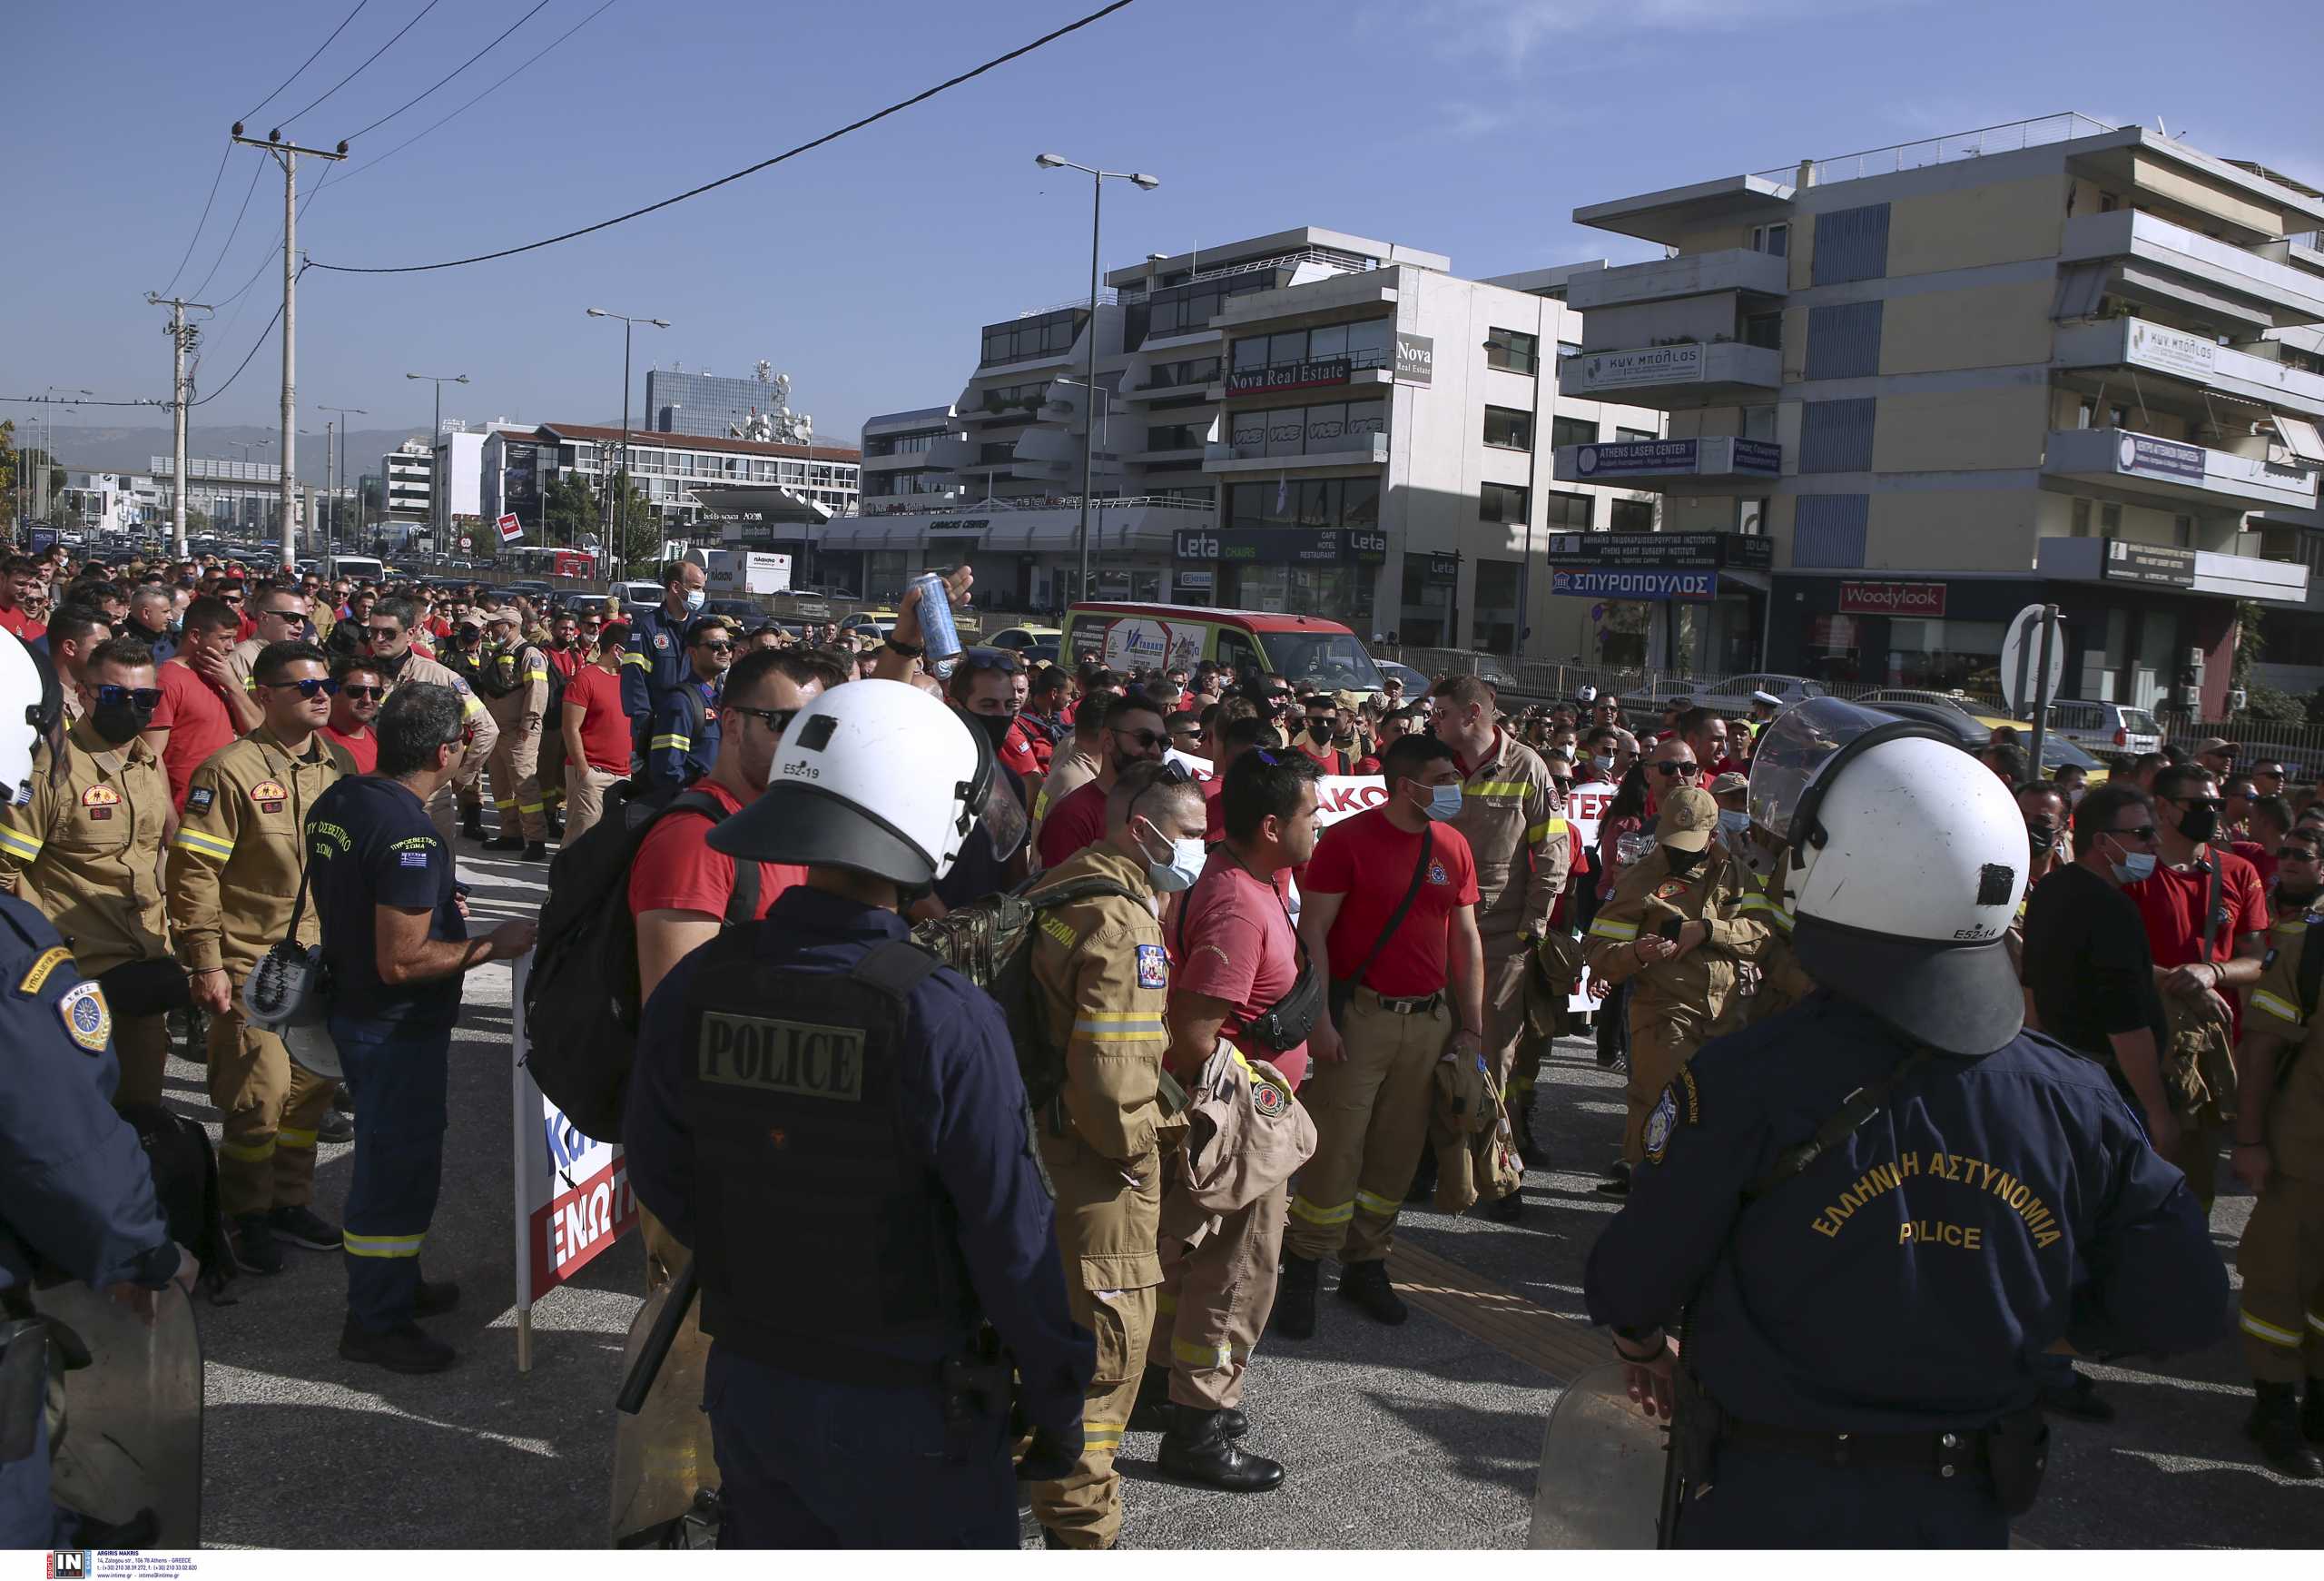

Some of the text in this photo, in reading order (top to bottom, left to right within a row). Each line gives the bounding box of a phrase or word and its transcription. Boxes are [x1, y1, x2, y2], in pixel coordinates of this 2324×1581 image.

[1396, 341, 1432, 363] Nova
[1230, 363, 1344, 390] Nova Real Estate
[1397, 362, 1432, 375] Real Estate
[1271, 425, 1302, 441] VICE
[1308, 421, 1344, 439] VICE
[1600, 443, 1686, 459] ATHENS LASER CENTER
[1321, 531, 1336, 539] CAFE
[1352, 532, 1385, 551] Leta
[1177, 532, 1219, 558] Leta
[1317, 541, 1336, 549] HOTEL
[1300, 551, 1336, 559] RESTAURANT
[1432, 560, 1454, 573] Leta
[1573, 573, 1708, 594] ΣΠΥΡΟΠΟΥΛΟΣ
[1847, 588, 1937, 608] Woodylook
[784, 764, 819, 778] E52-19
[307, 821, 351, 852] ΠΥΟΣΒΕΣΤΙΚΟ
[390, 836, 438, 851] ΠΥΡΟΣΒΕΣΤΙΚΟ
[1954, 928, 1996, 939] E52-14
[707, 1018, 856, 1094] POLICE
[1811, 1151, 2062, 1250] ΕΛΛΗΝΙΗ ΑΣΤΥΝΟΜΙΑ
[1898, 1220, 1981, 1250] POLICE
